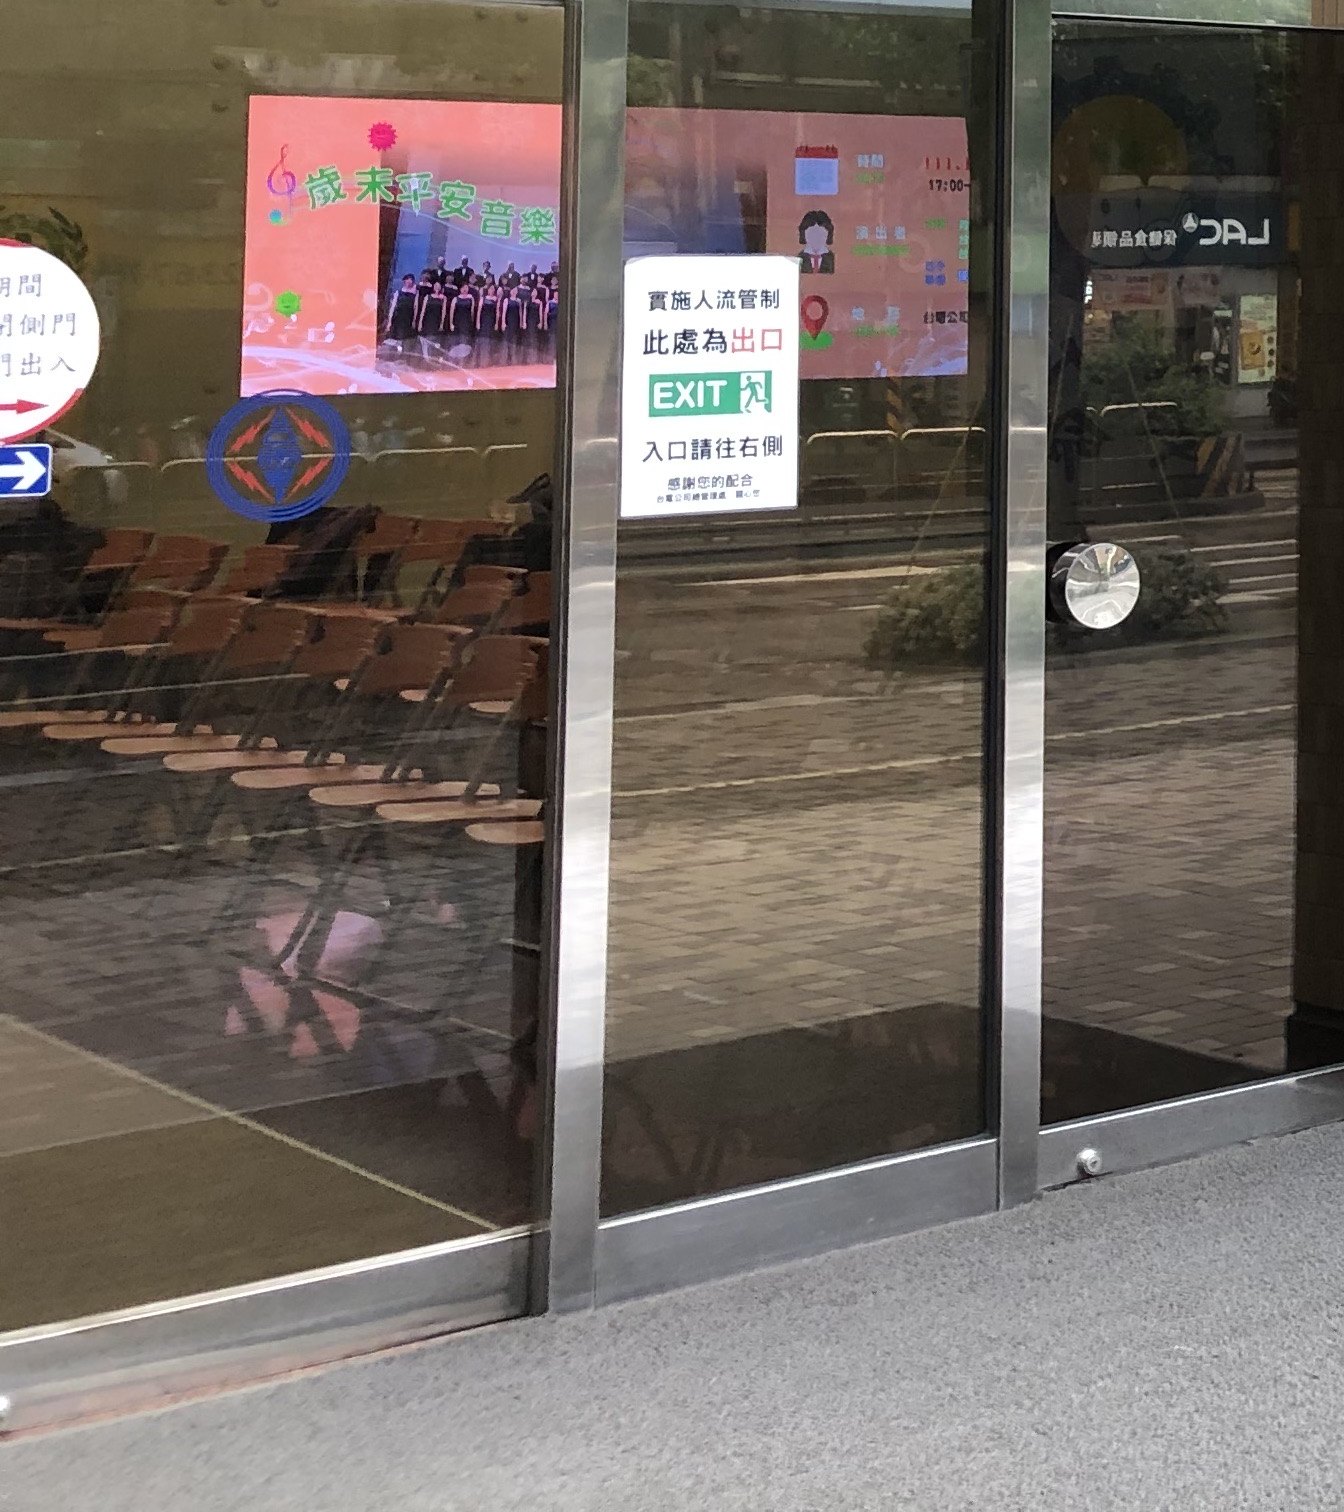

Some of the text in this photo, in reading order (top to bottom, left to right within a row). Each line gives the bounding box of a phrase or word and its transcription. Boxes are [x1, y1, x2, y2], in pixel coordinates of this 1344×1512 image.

[304, 165, 557, 245] 歲末平安音樂
[648, 289, 780, 311] 實施人流管制
[643, 327, 783, 355] 此處為出口
[653, 379, 728, 410] EXIT
[642, 435, 783, 463] 入口請往右側
[667, 473, 754, 490] 感謝您的配合
